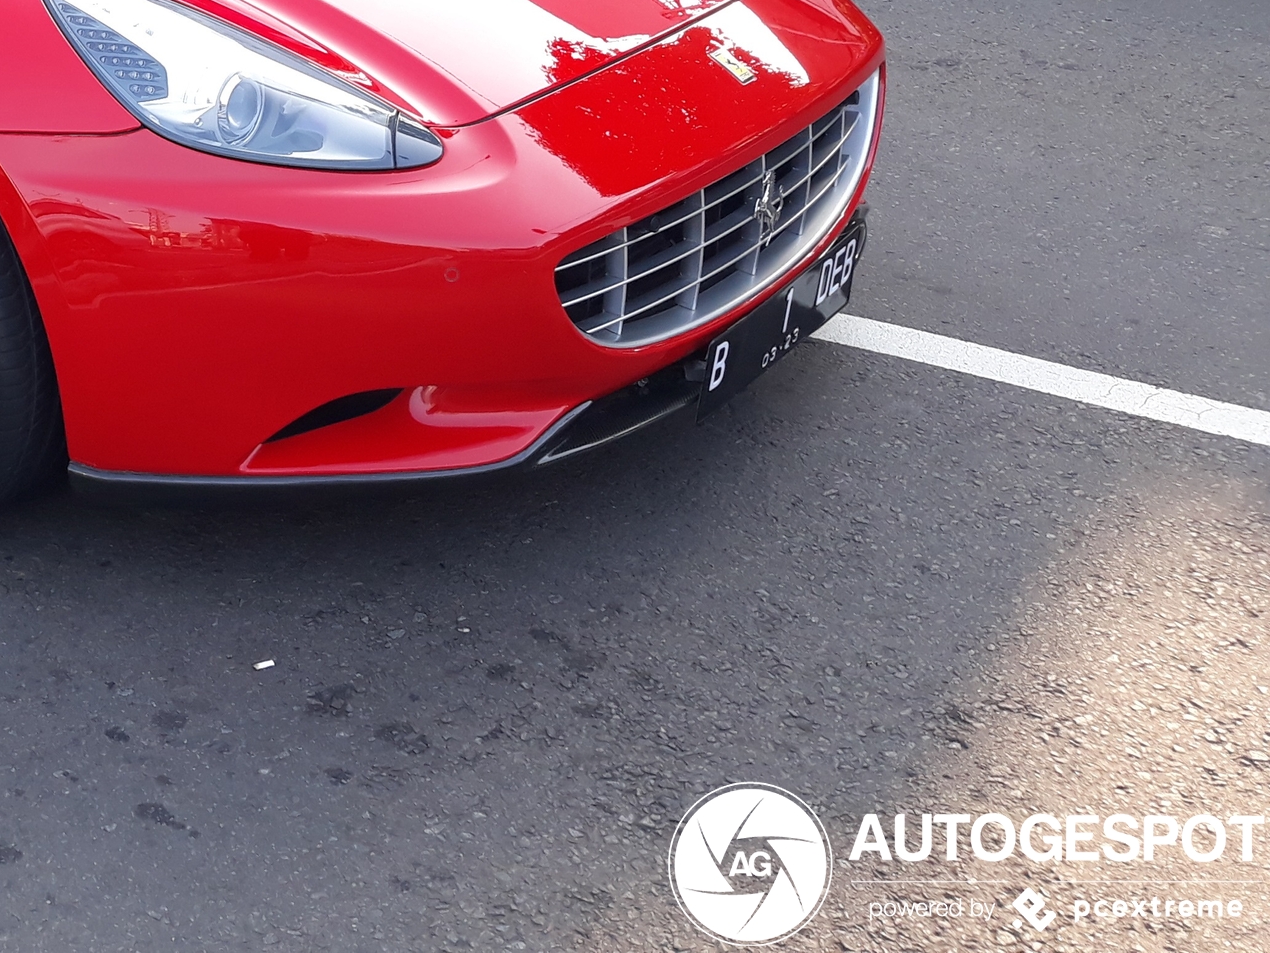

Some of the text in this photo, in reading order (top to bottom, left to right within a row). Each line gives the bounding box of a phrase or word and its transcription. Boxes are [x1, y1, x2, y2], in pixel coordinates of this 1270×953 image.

[709, 238, 857, 391] B 1 DEB
